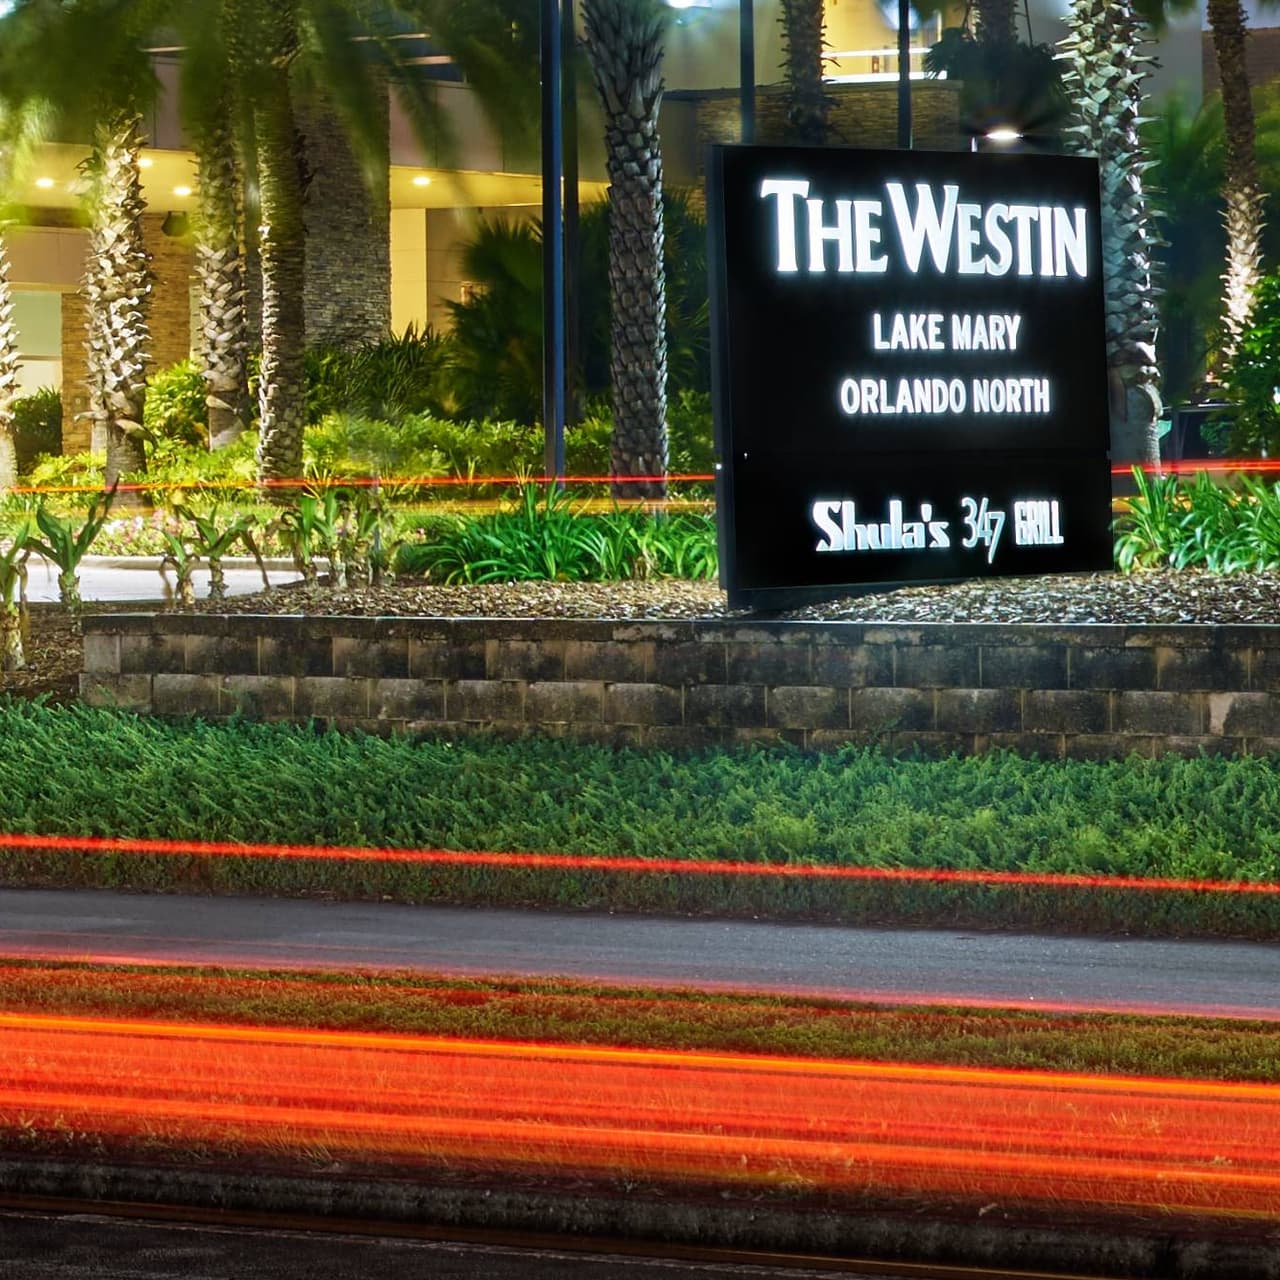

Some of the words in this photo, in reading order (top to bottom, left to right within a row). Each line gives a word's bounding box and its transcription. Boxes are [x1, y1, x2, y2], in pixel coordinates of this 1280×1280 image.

[759, 178, 889, 274] THE
[885, 181, 1088, 278] WESTIN
[872, 312, 945, 351] LAKE
[951, 313, 1022, 351] MARY
[840, 377, 967, 415] ORLANDO
[972, 377, 1051, 414] NORTH
[812, 498, 951, 552] Shula's
[1013, 499, 1065, 546] GRILL
